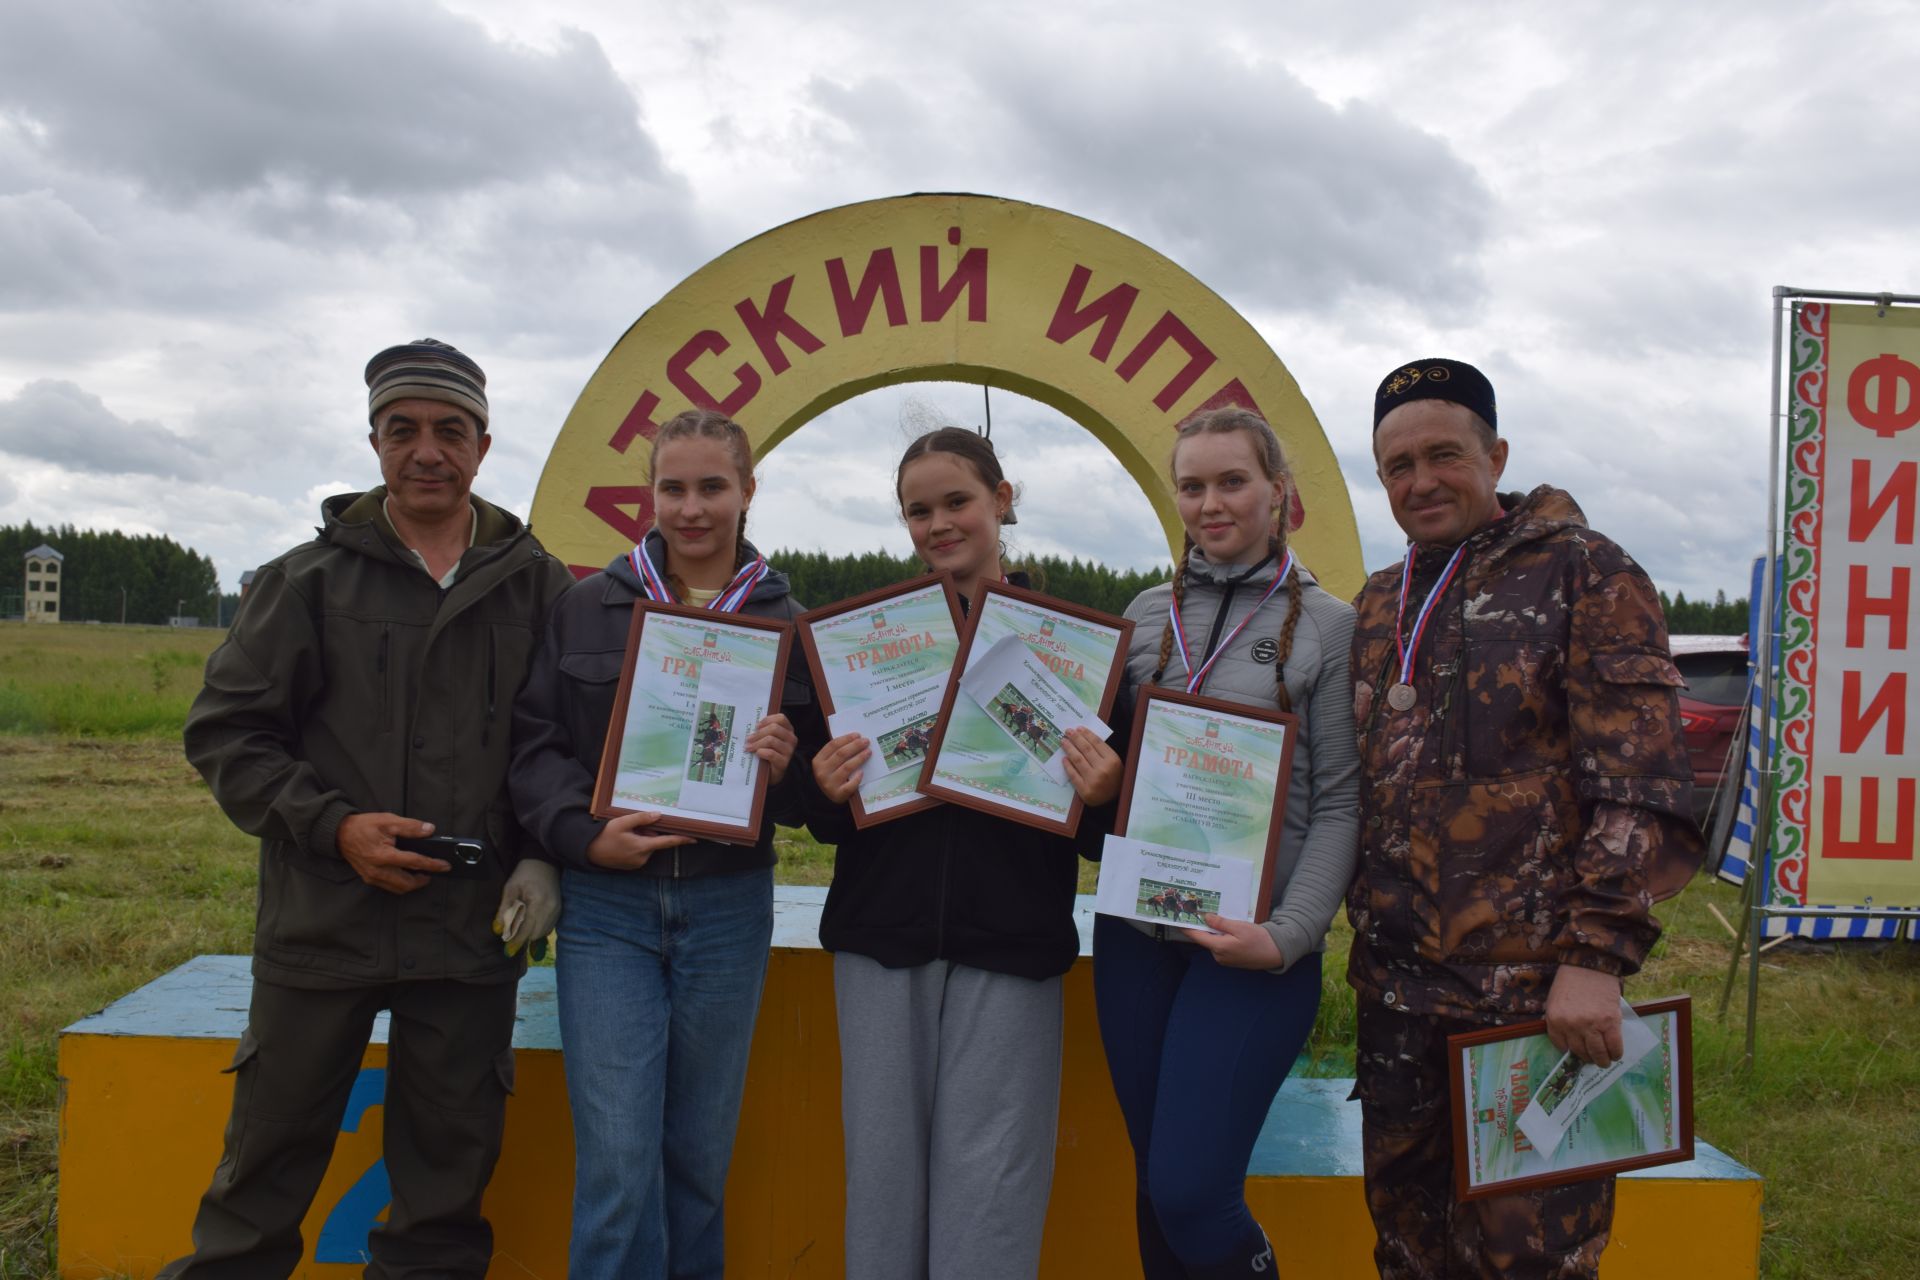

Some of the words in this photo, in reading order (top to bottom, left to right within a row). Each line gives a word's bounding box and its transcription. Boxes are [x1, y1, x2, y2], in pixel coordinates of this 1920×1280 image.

[568, 226, 989, 580] АТСКИЙ
[845, 631, 937, 672] ГРАМОТА
[1821, 353, 1920, 861] ФИНИШ
[1163, 745, 1255, 780] ГРАМОТА
[1510, 1058, 1534, 1153] ГРМОТА
